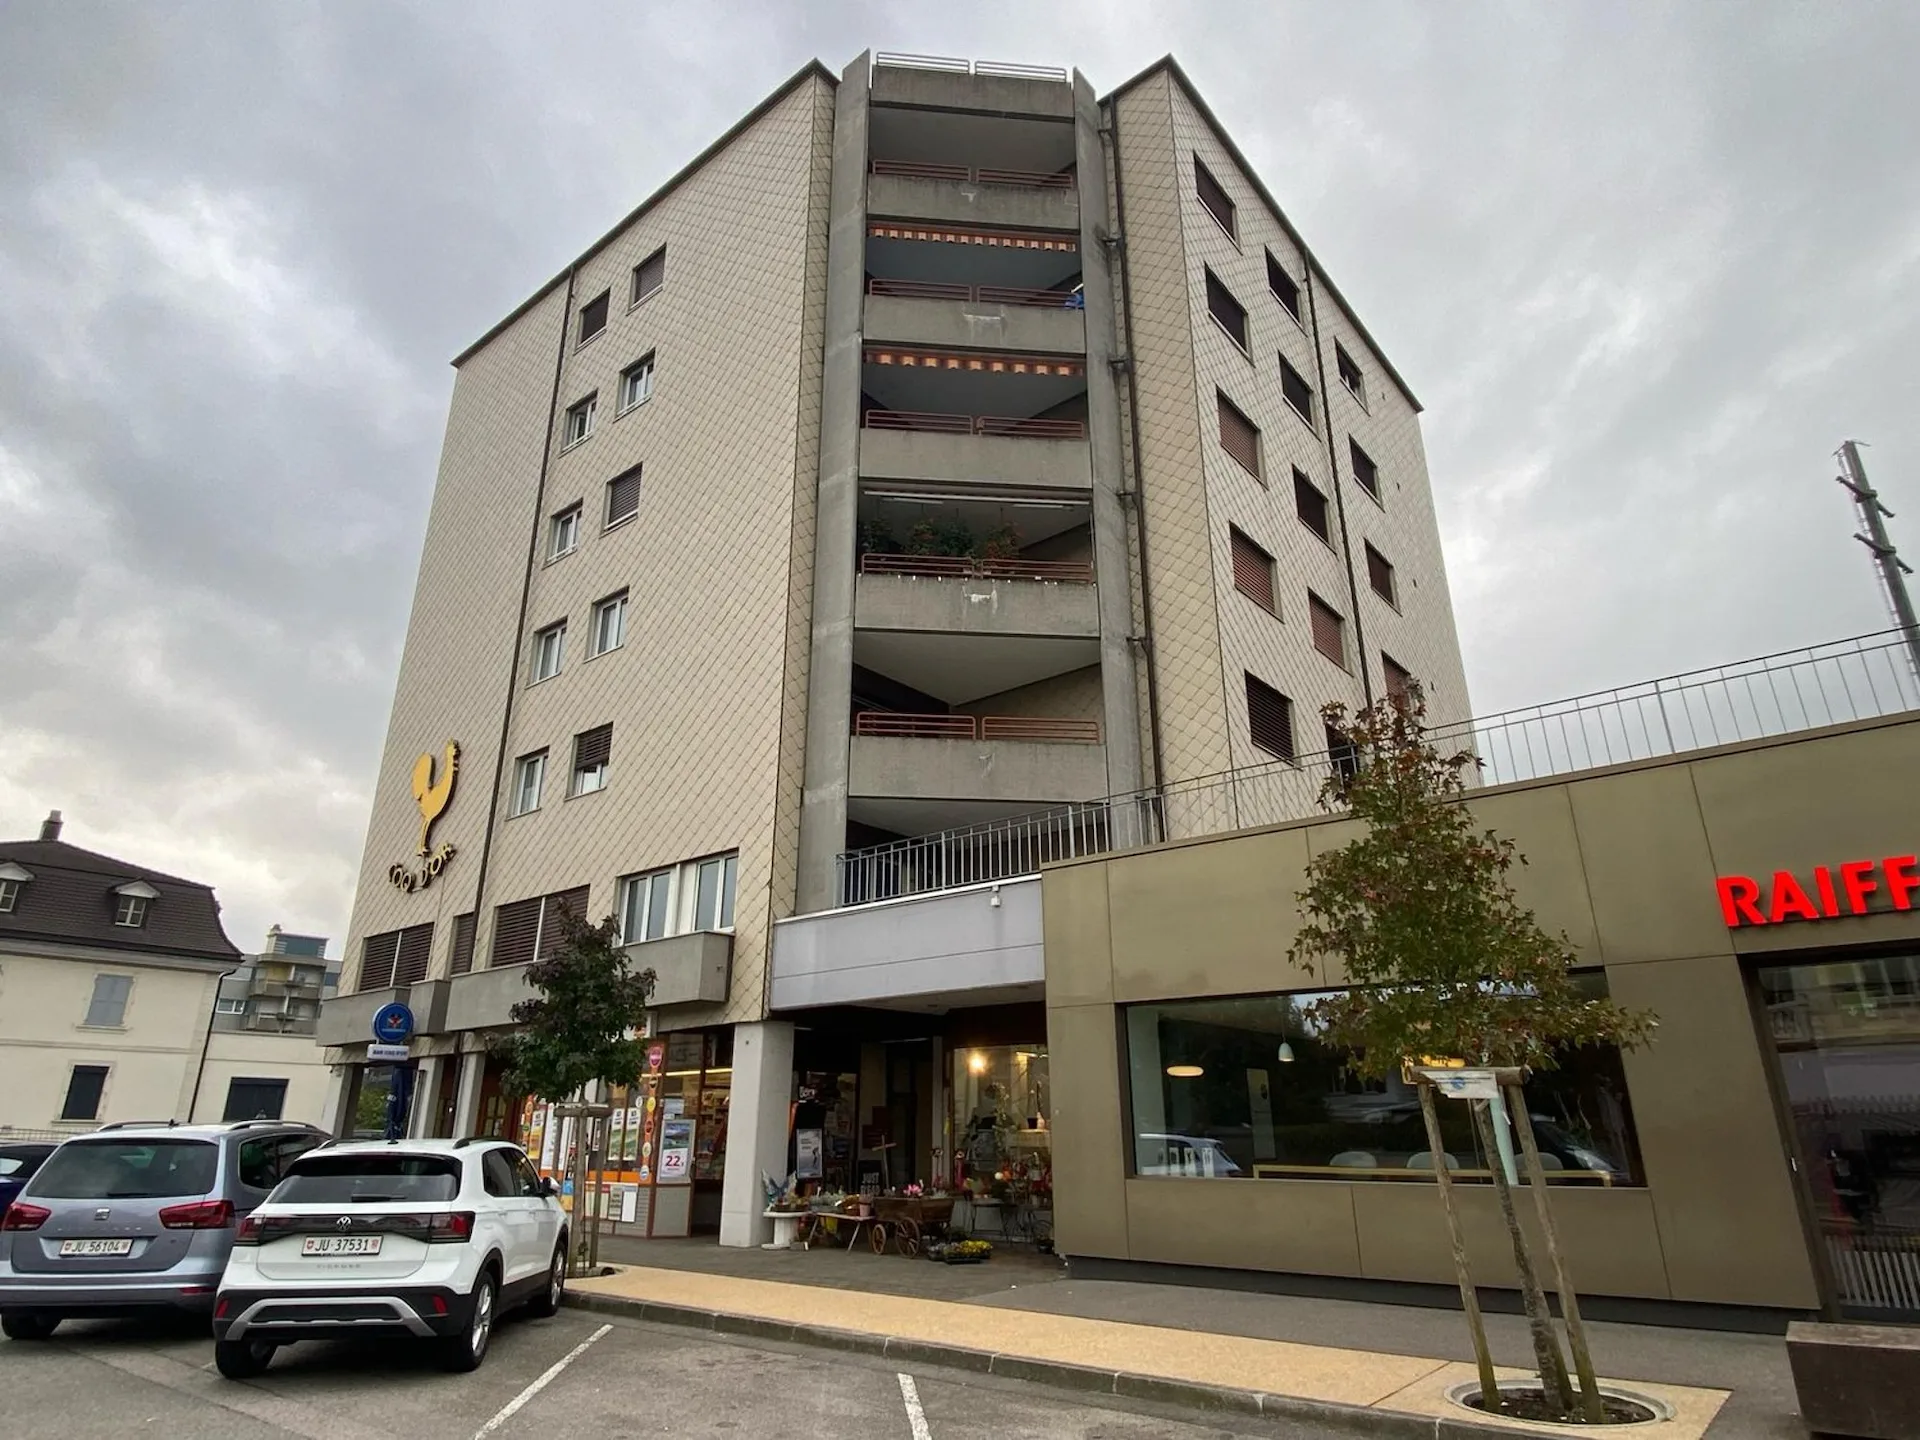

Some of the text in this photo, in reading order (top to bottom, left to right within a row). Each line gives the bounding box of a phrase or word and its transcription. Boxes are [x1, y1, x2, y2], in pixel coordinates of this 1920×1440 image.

[1715, 855, 1920, 928] RAIFF
[72, 1240, 121, 1252] JU 56104
[315, 1239, 368, 1251] JU 37531
